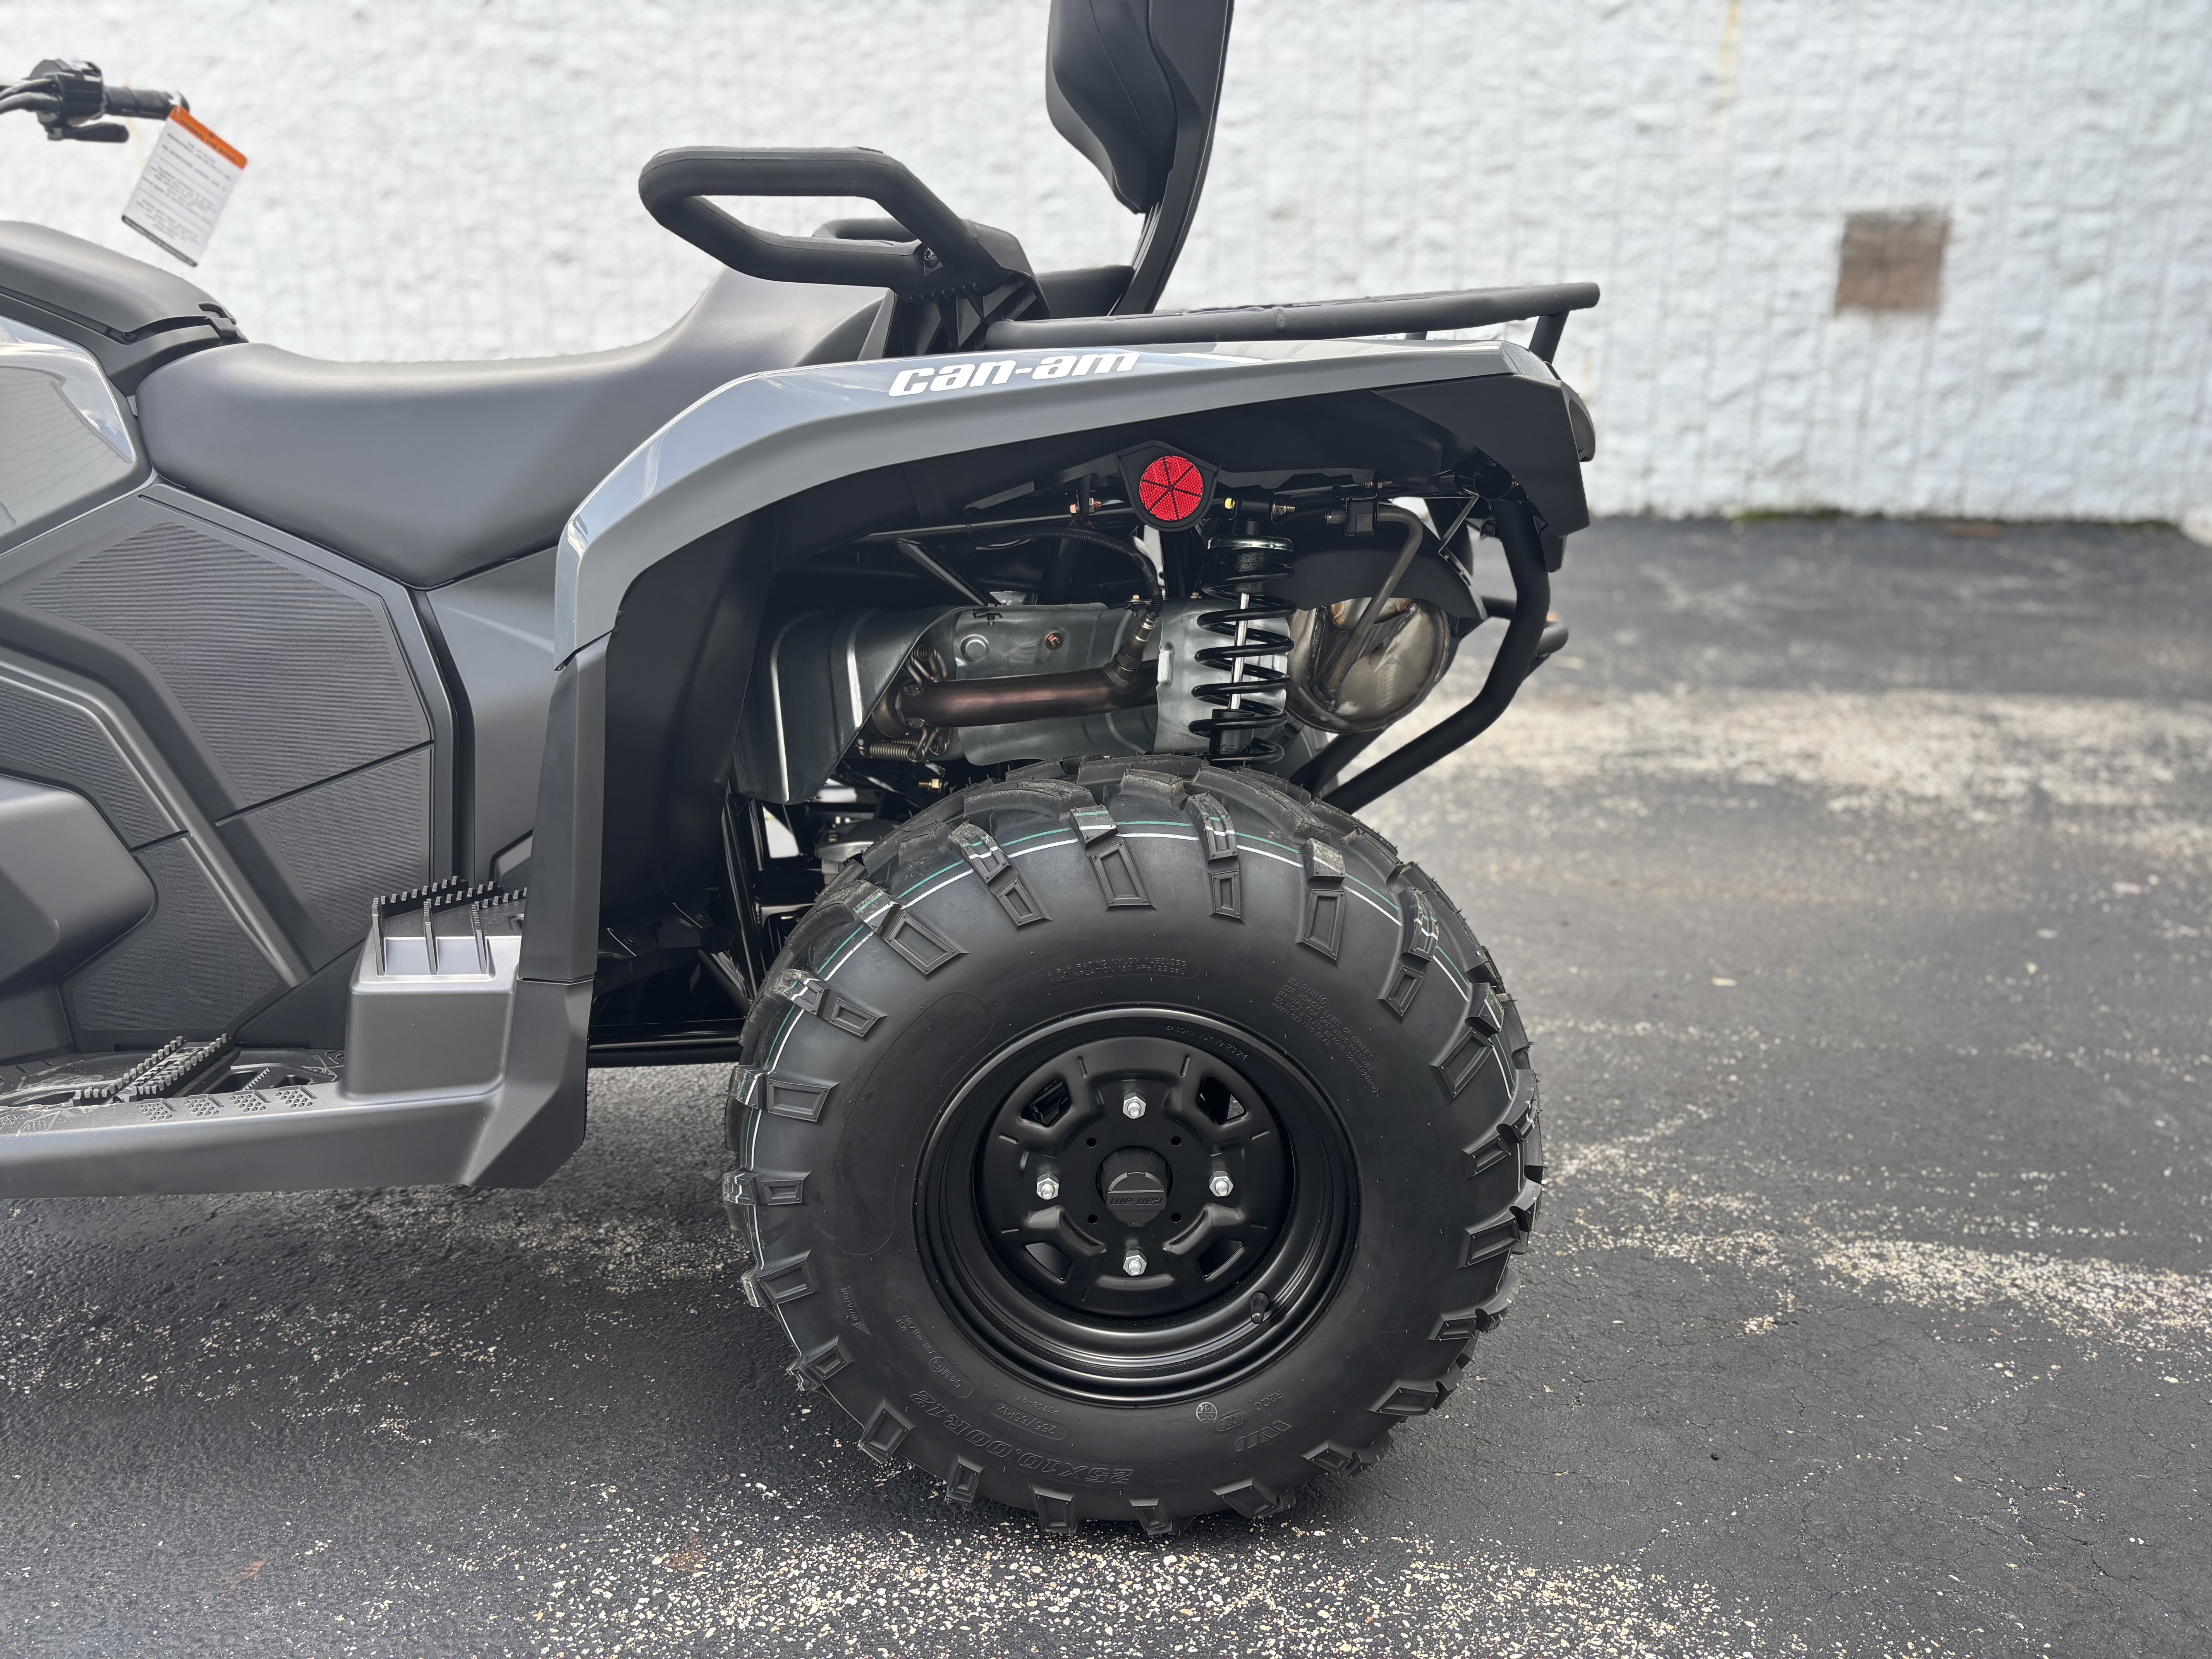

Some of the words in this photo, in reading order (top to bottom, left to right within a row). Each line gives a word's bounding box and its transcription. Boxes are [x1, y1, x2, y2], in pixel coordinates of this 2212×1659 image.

[888, 352, 1140, 397] can-am
[1072, 966, 1114, 977] INFLATION
[1077, 960, 1106, 969] RATING
[1145, 957, 1187, 967] TUBELESS
[1271, 1002, 1289, 1014] WHEN
[1290, 1013, 1315, 1032] SEATING
[1278, 991, 1305, 1008] MANUAL
[1305, 1006, 1318, 1016] FOR
[1319, 1016, 1349, 1043] OPERATING
[1283, 984, 1296, 994] SEE
[1297, 992, 1323, 1012] VEHICLE
[1324, 1012, 1342, 1027] LABEL
[1285, 1003, 1299, 1012] NOT
[1300, 1012, 1324, 1030] INFLATE
[1324, 1030, 1345, 1051] BEYOND
[840, 1287, 859, 1321] ROTATION
[910, 1389, 1133, 1484] 25X10.00R12
[996, 1403, 1057, 1434] 255/65R12
